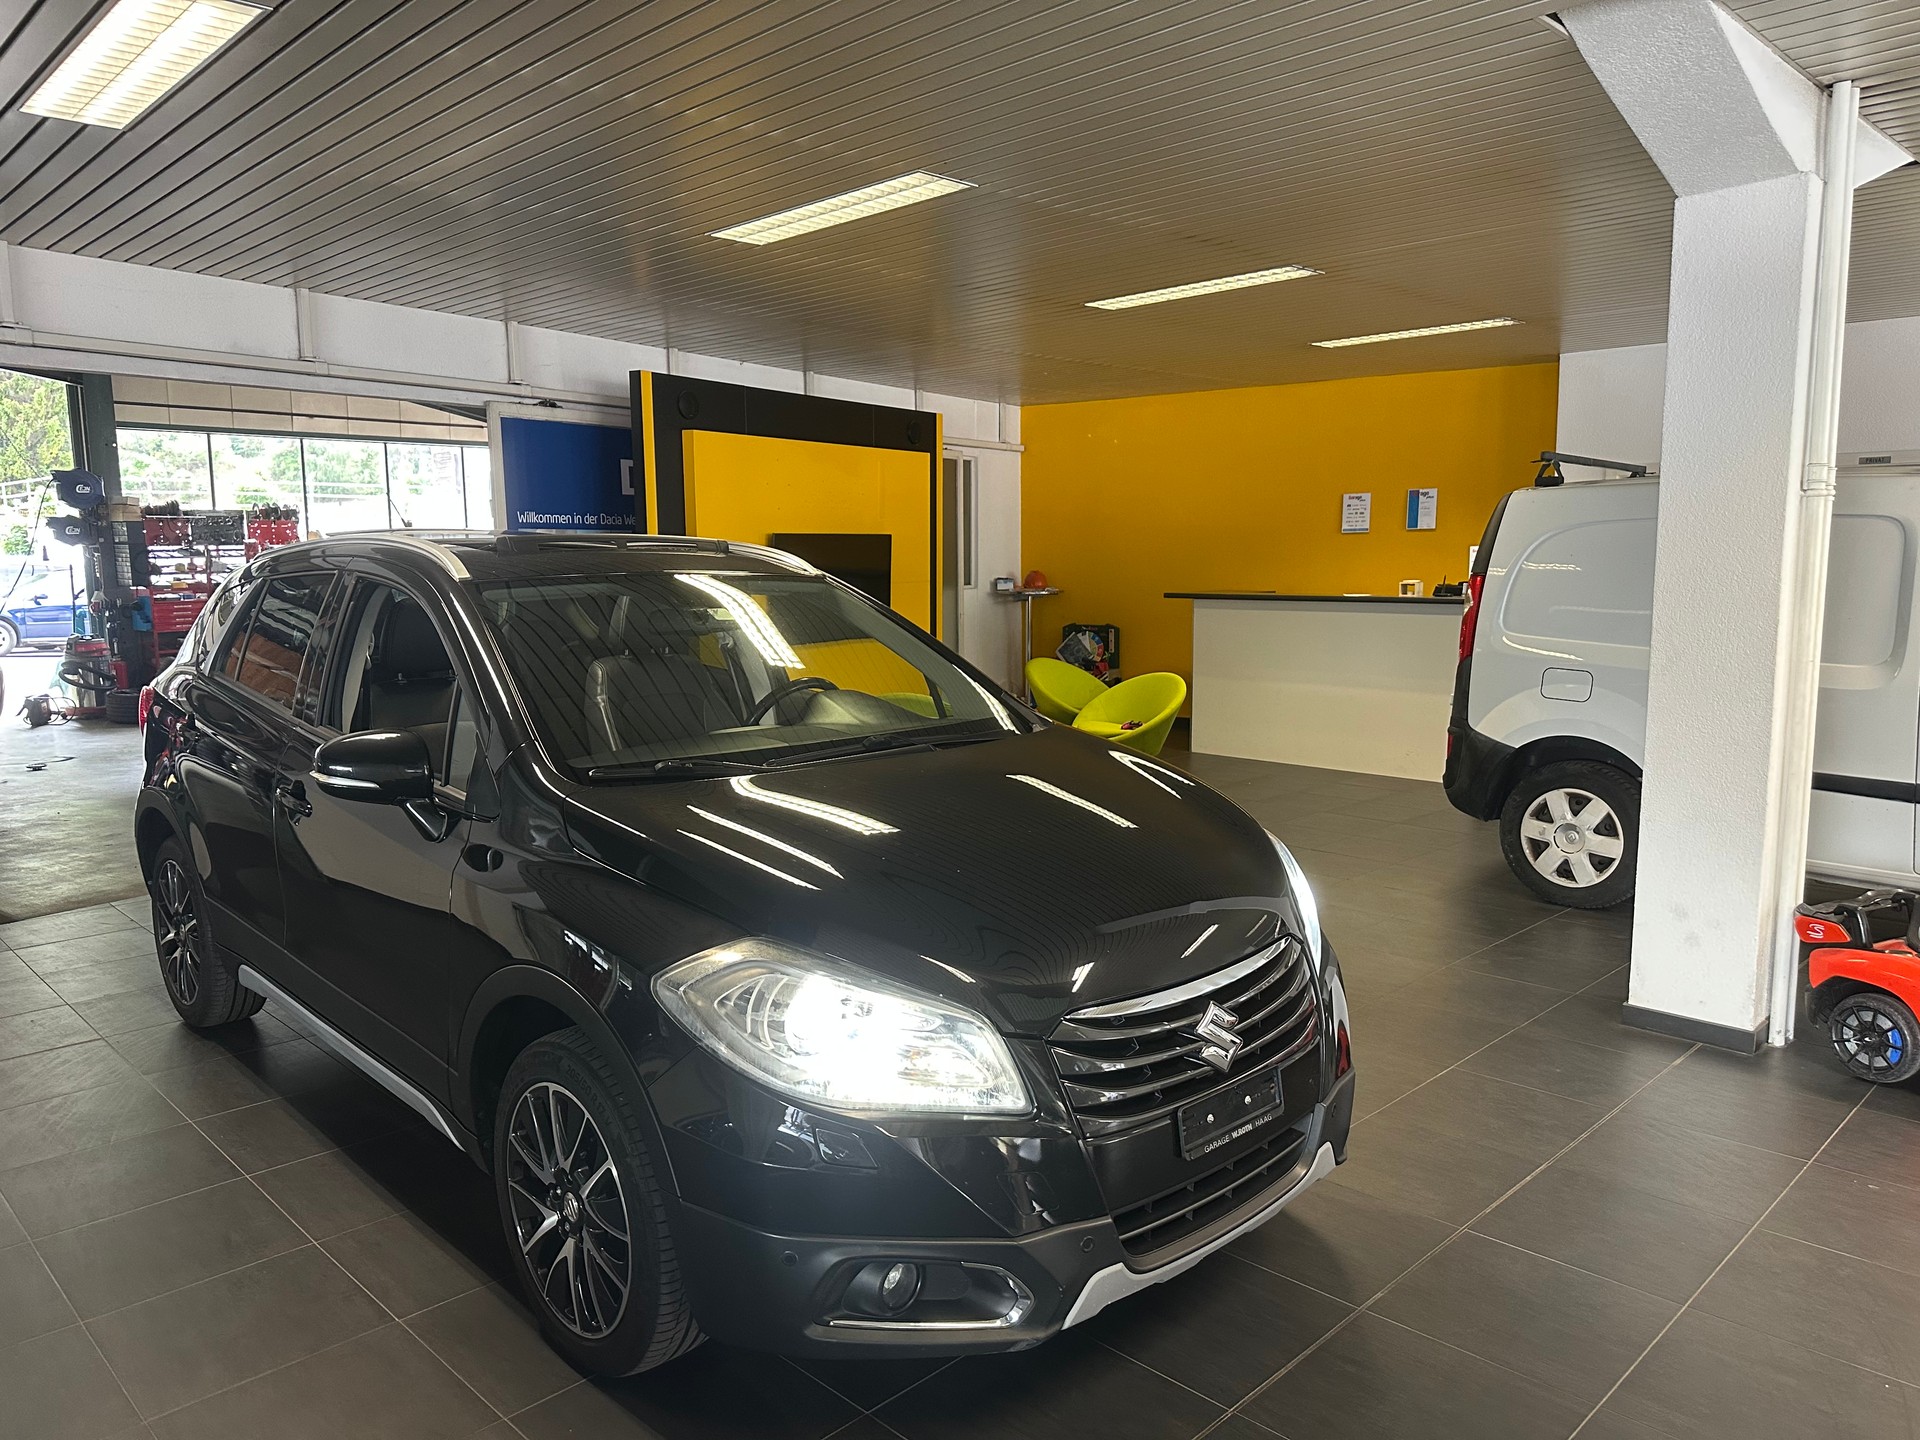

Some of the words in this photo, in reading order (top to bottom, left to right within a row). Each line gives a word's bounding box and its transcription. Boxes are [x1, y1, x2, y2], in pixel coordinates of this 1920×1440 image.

[517, 511, 572, 524] Willkommen
[574, 512, 582, 524] in
[584, 513, 598, 524] der
[600, 513, 622, 525] Dacia
[1204, 1135, 1230, 1153] GARAGE
[1255, 1113, 1273, 1127] HAAG
